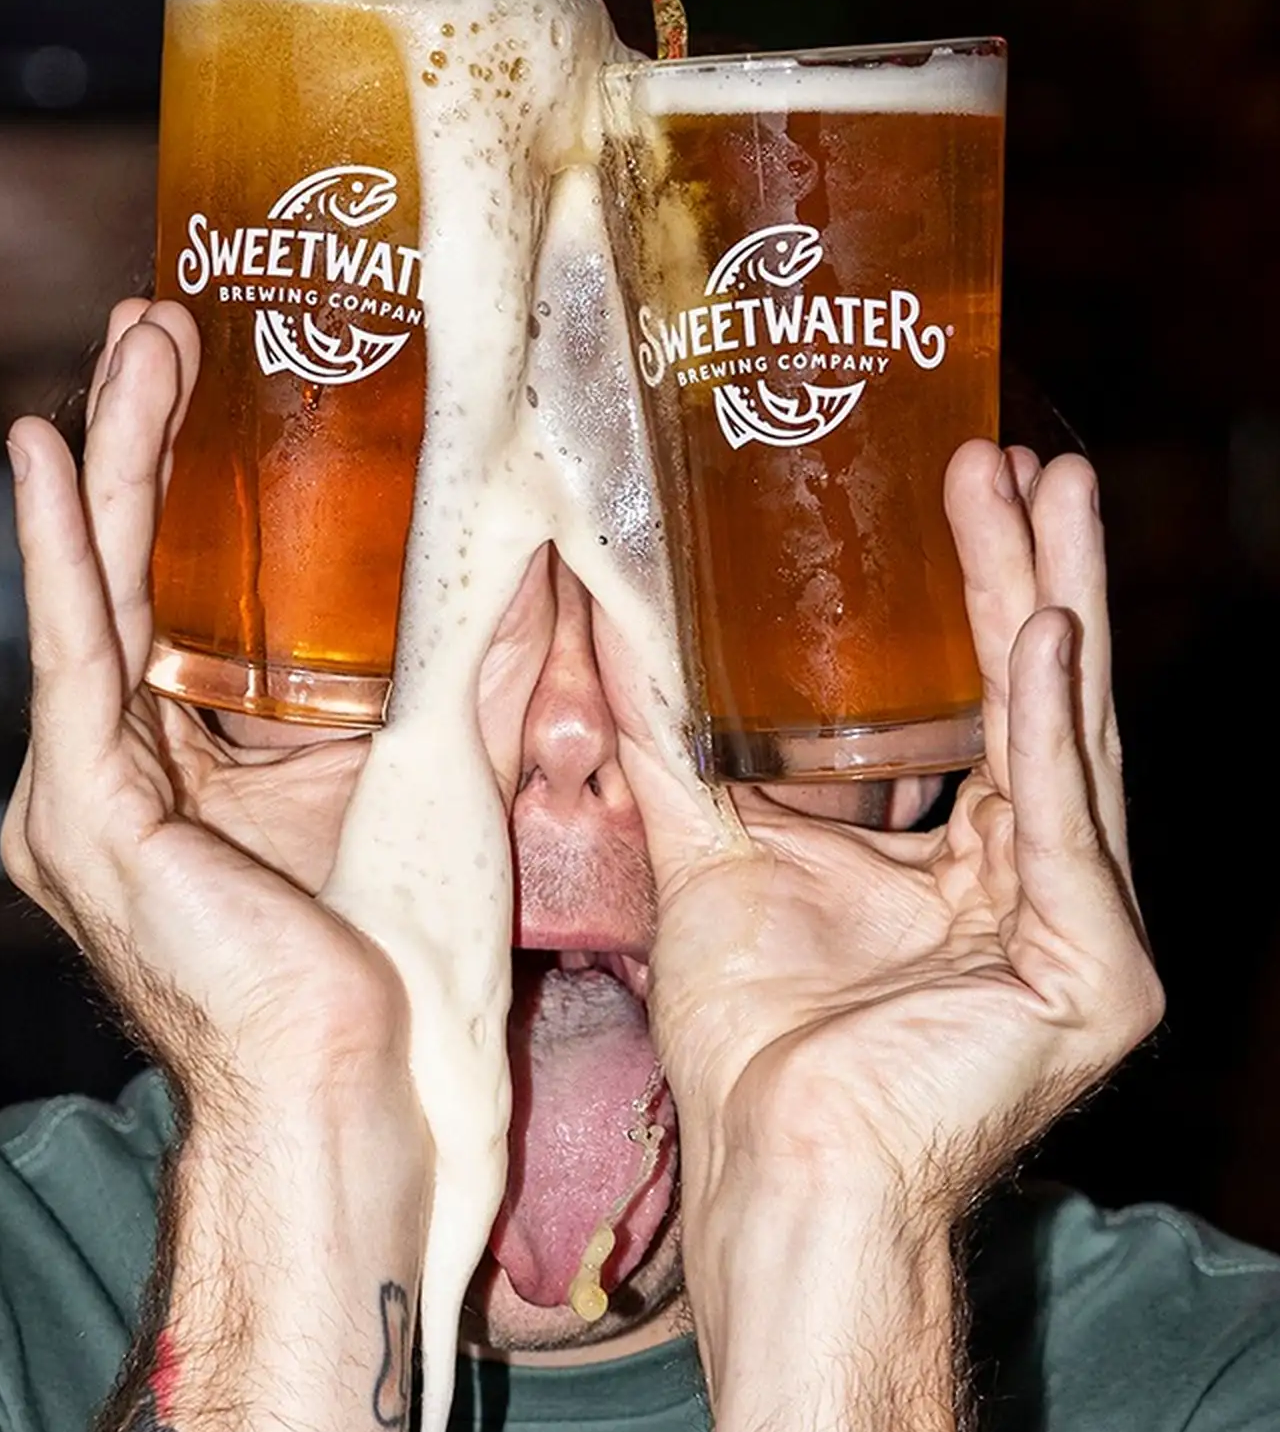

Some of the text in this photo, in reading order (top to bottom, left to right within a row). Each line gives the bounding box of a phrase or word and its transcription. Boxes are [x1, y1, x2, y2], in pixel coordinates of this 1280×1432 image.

[177, 212, 425, 301] SWEETWAT
[219, 285, 428, 328] BREWING COMPAN
[637, 288, 946, 388] SWEETWATER
[677, 351, 890, 387] BREWING COMPANY
